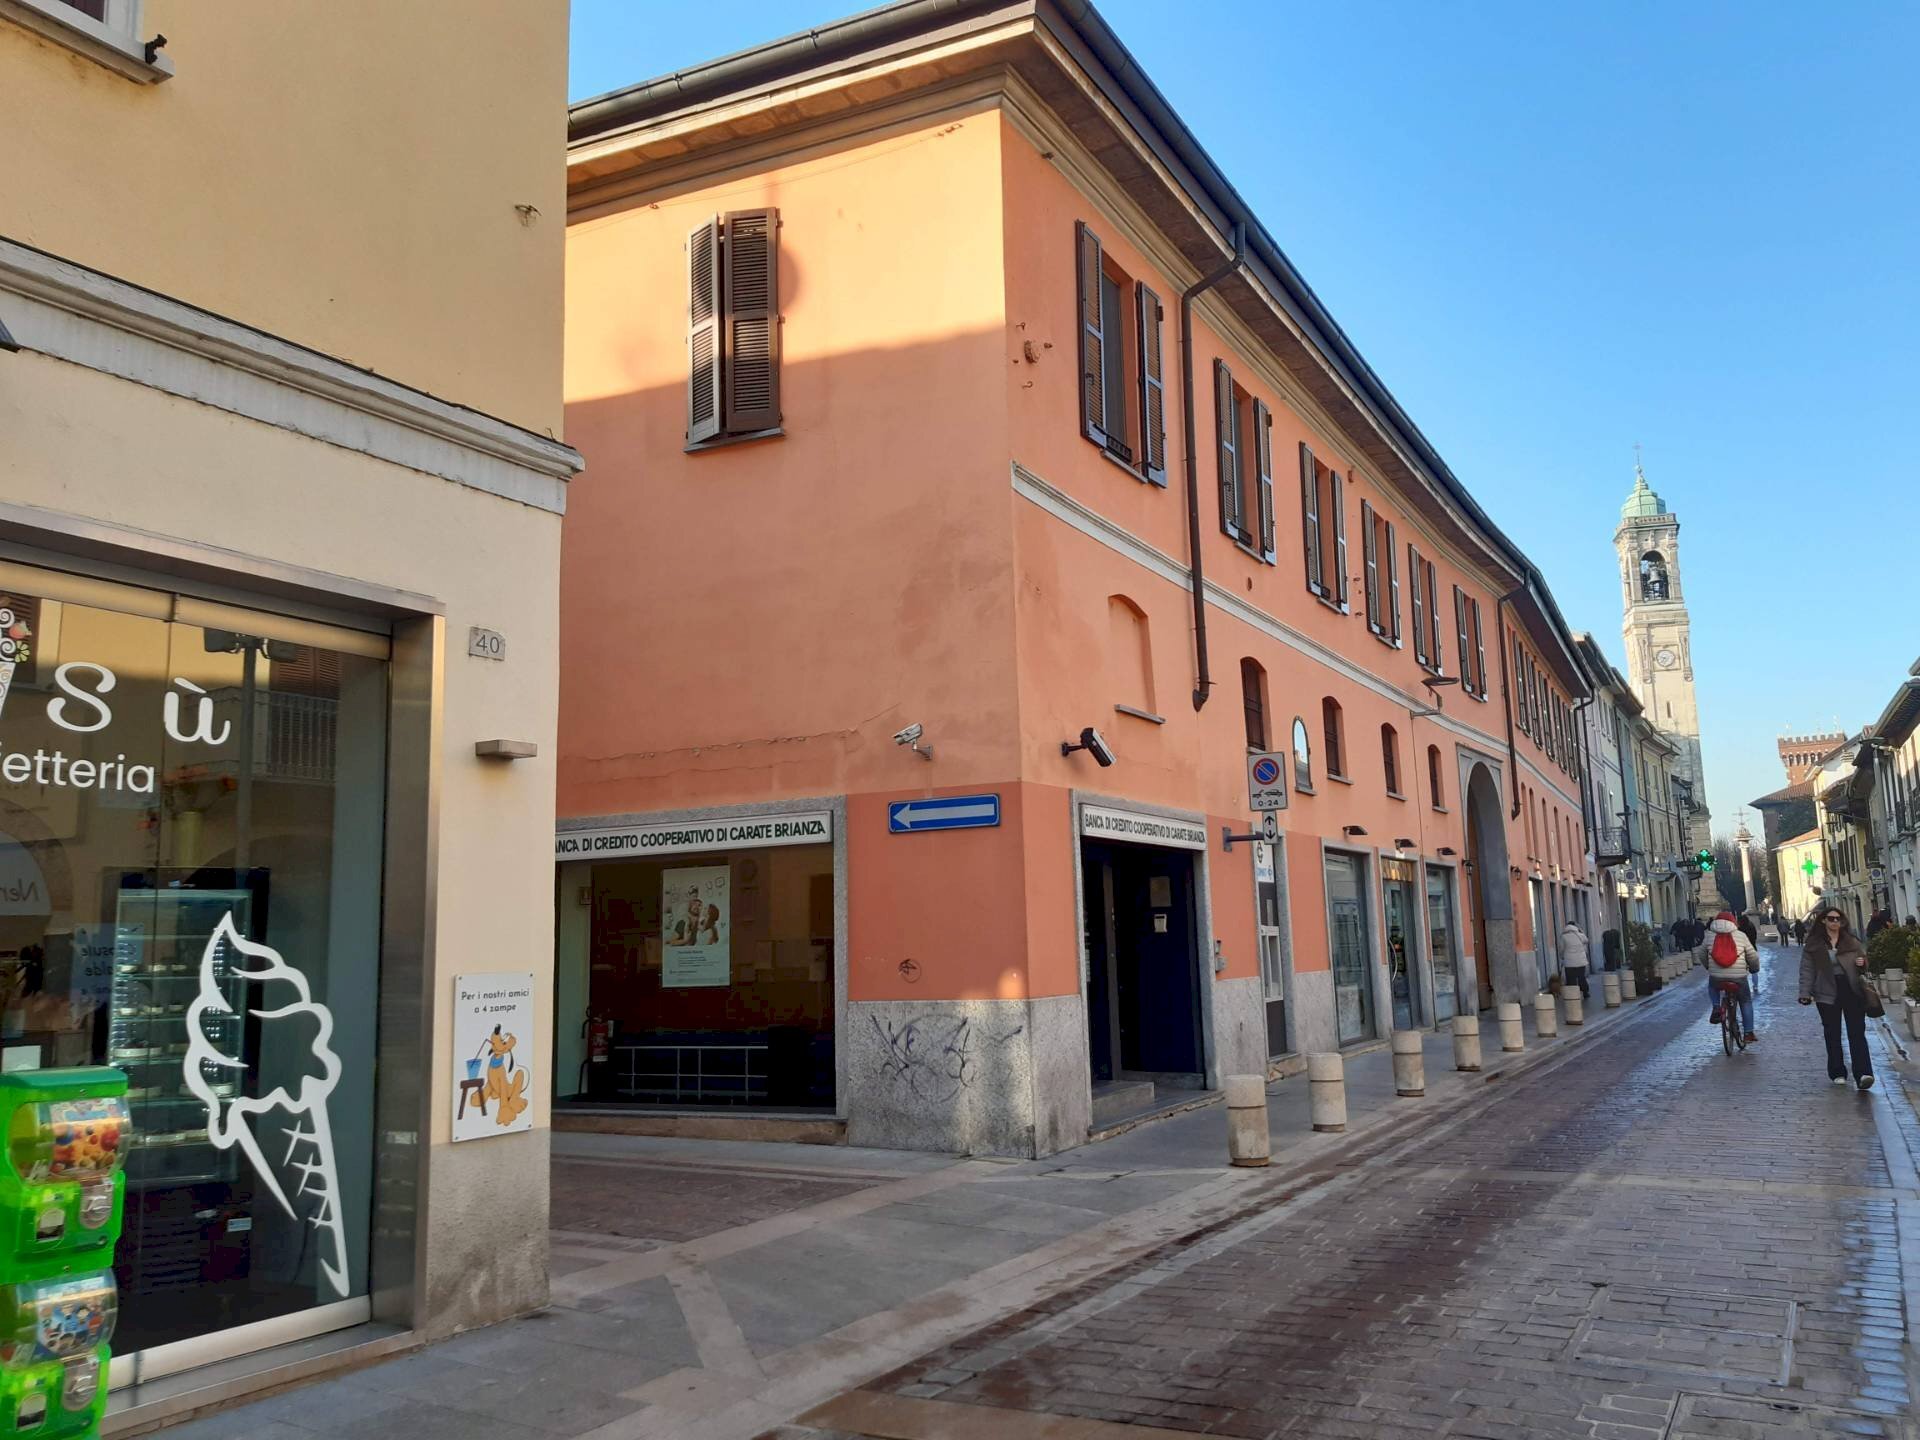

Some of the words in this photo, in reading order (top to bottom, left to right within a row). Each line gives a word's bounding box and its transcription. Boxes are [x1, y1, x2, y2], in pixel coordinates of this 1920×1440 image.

[476, 634, 500, 654] 40
[0, 742, 155, 793] etteria
[582, 838, 592, 852] DI
[594, 834, 638, 850] CREDITO
[640, 829, 715, 847] COOPERATIVO
[717, 827, 728, 842] DI
[729, 824, 772, 841] CARATE
[774, 820, 826, 838] BRIANZA
[1085, 813, 1105, 829] BANCA
[1105, 816, 1111, 830] DI
[1111, 817, 1133, 833] CREDITO
[1133, 820, 1165, 838] COOPERATIVO
[1170, 826, 1187, 841] CARATE
[1187, 829, 1206, 843] BRIANZA
[461, 991, 476, 1001] Per
[483, 989, 506, 1000] nostri
[508, 988, 530, 999] amici
[482, 1005, 487, 1013] 4
[490, 1004, 517, 1013] zampe
